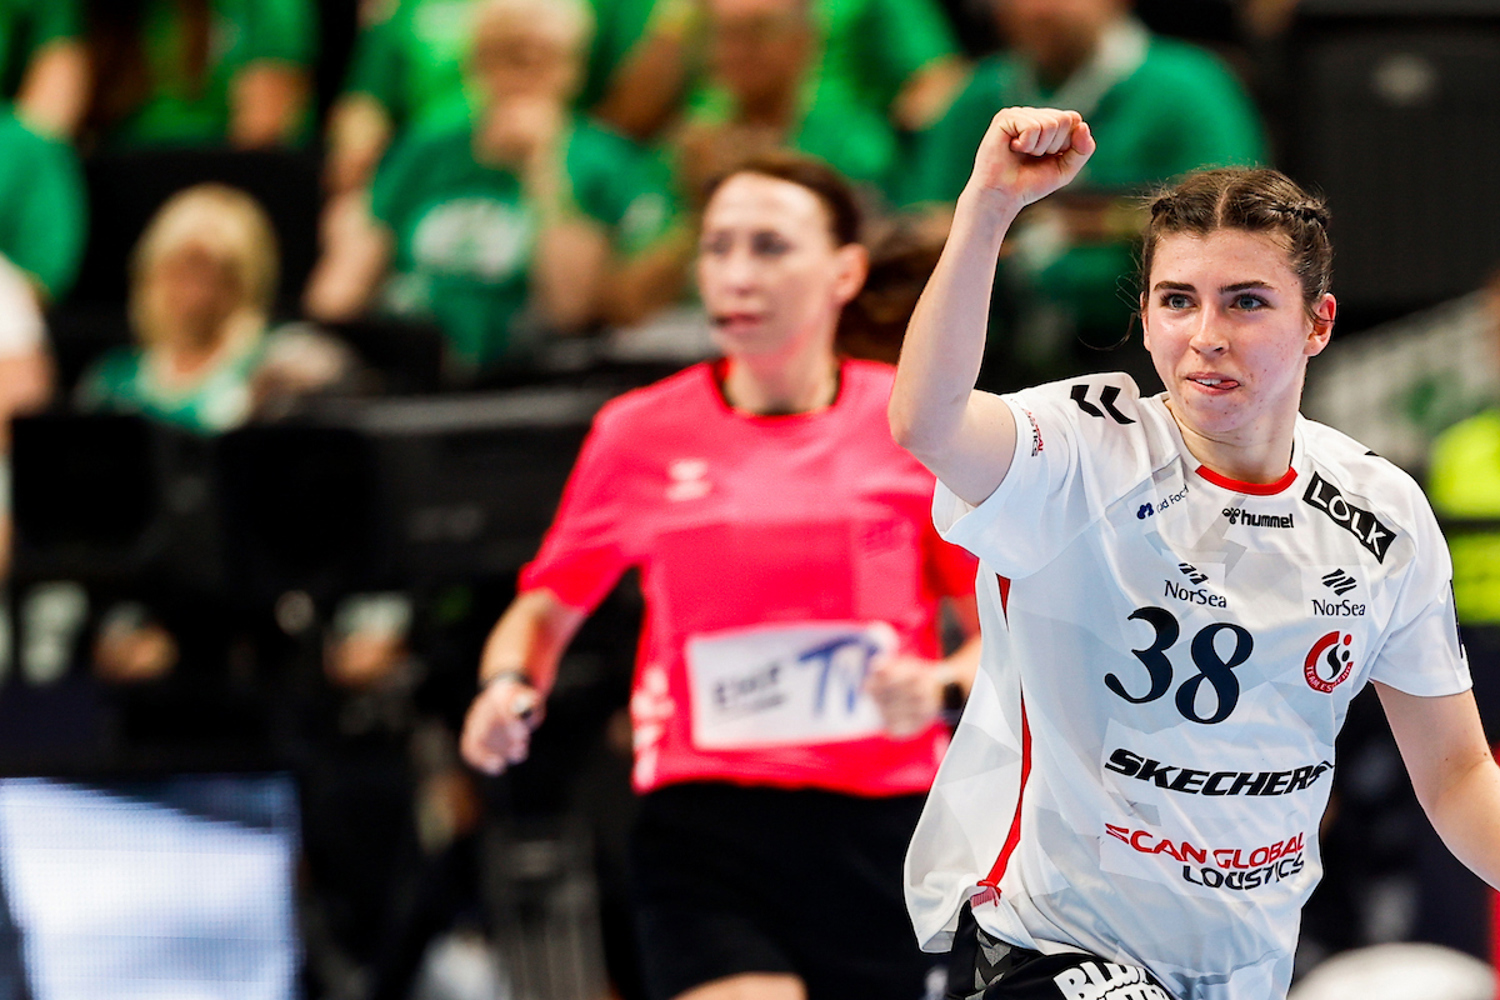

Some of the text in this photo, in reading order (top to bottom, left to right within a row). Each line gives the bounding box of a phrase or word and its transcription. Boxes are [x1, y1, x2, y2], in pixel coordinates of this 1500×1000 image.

[1240, 509, 1295, 529] hummel
[1310, 479, 1387, 557] LOLK
[1164, 579, 1227, 608] NorSea
[1311, 599, 1366, 617] NorSea
[1104, 606, 1254, 725] 38
[1104, 822, 1305, 869] SCAN GLOBAL
